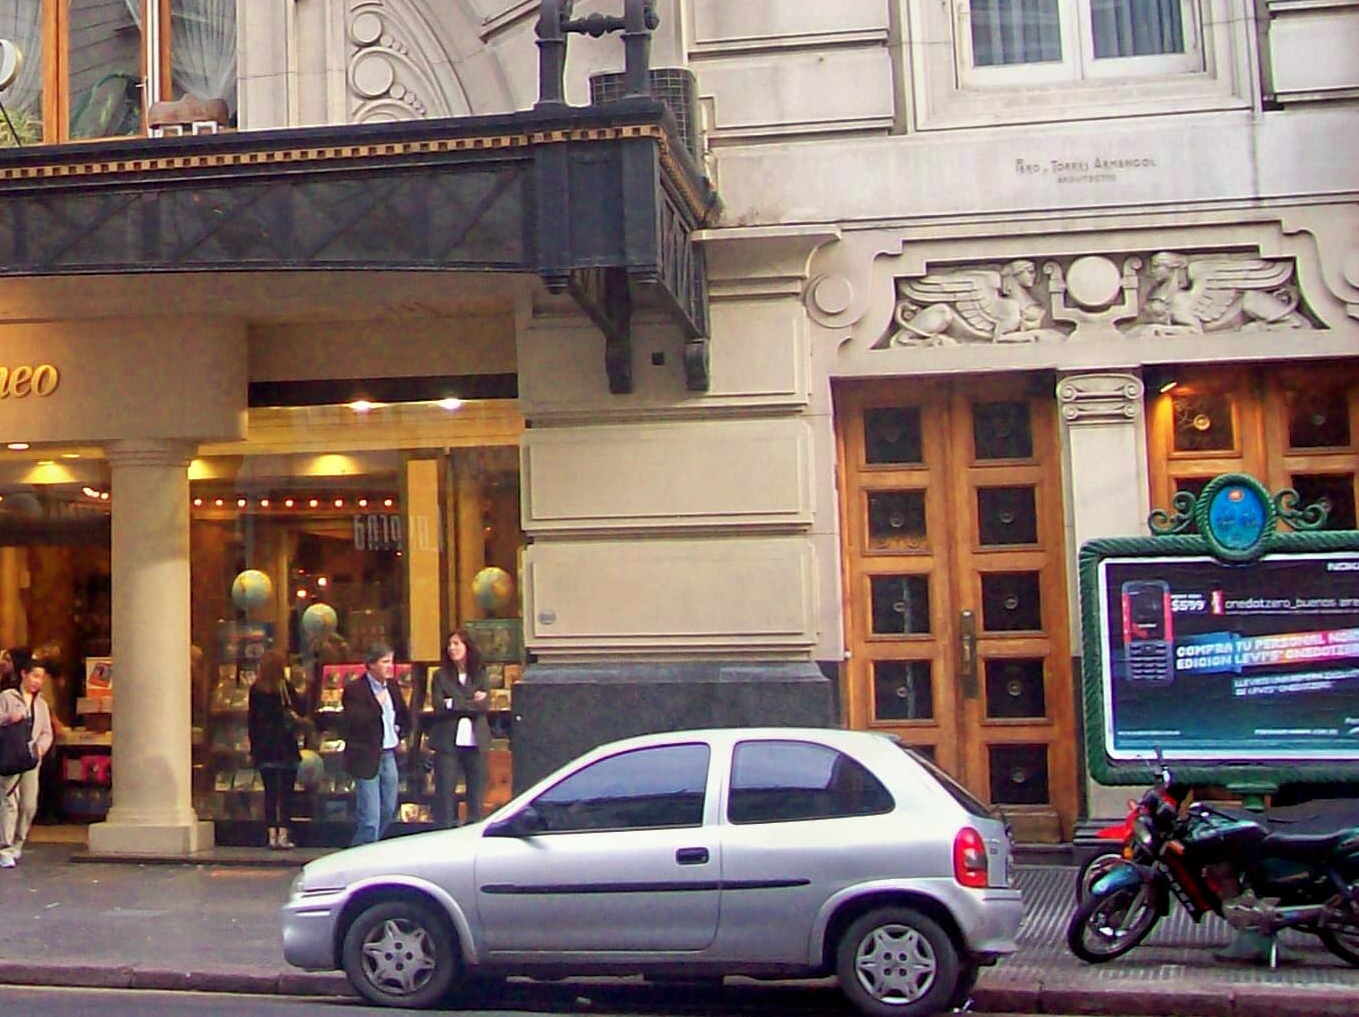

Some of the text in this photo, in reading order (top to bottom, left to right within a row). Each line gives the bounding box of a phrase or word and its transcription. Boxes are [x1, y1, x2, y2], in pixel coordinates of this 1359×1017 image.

[1176, 643, 1233, 658] COMPRA
[1235, 639, 1252, 652] TU
[1176, 654, 1232, 670] EDICION
